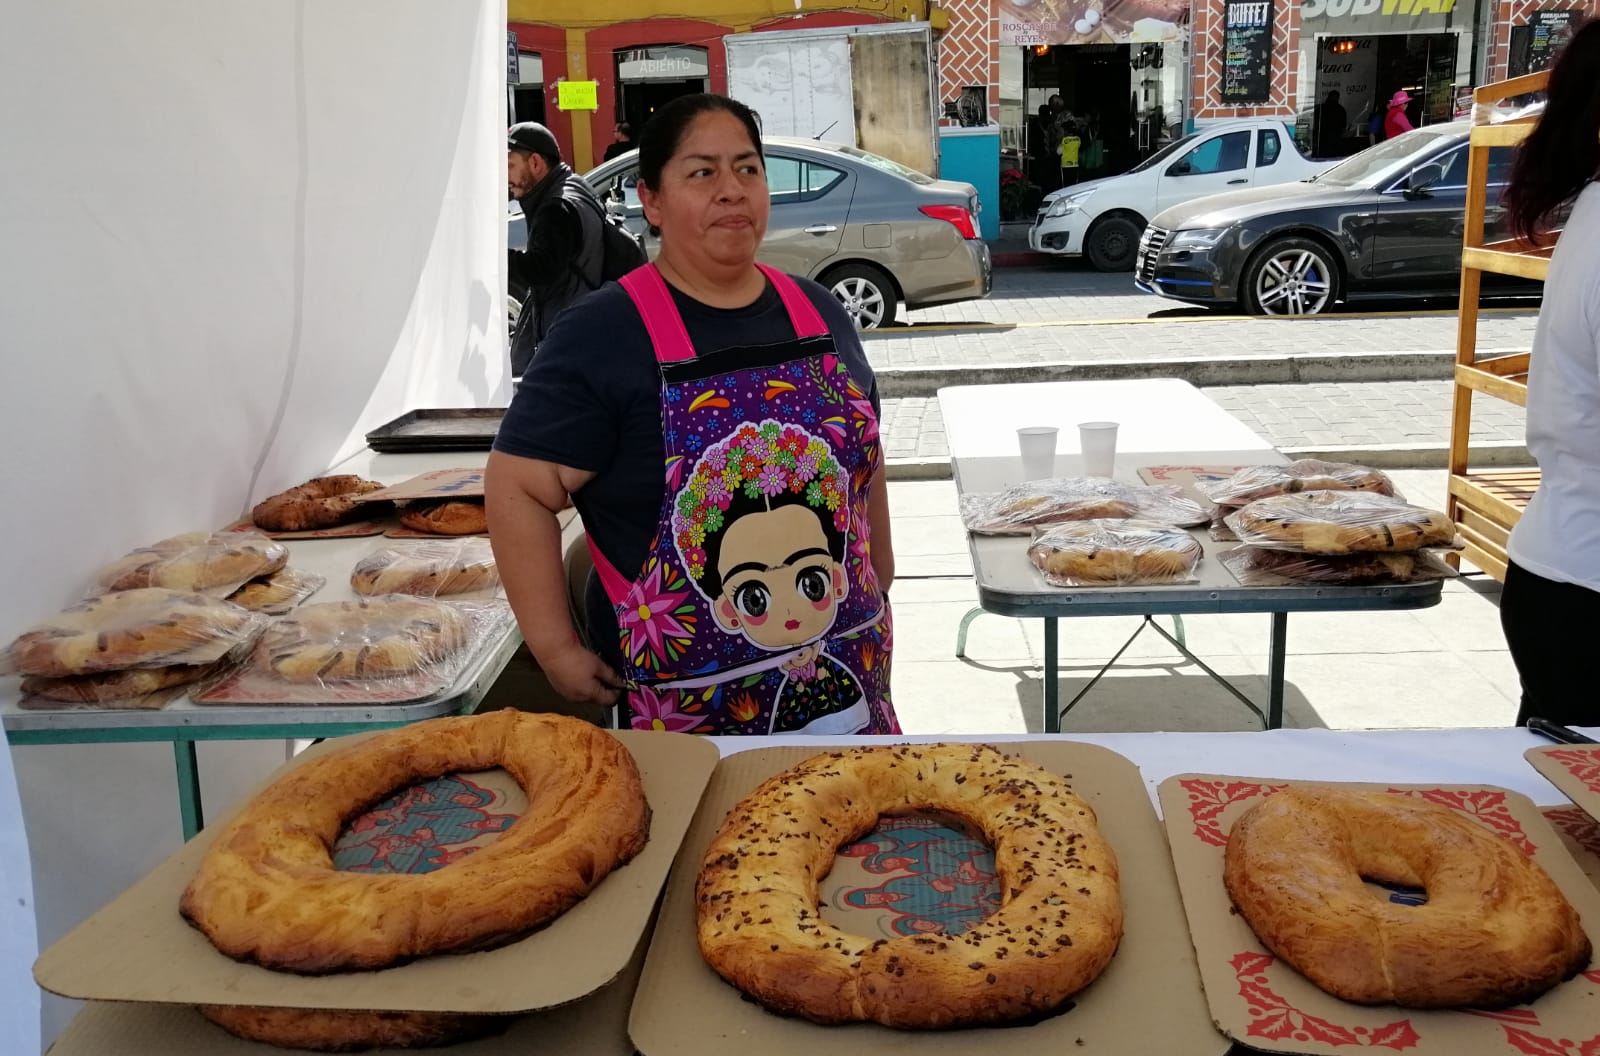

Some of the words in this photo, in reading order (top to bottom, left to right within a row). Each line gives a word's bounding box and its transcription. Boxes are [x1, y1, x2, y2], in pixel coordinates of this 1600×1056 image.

[1002, 23, 1041, 32] ROSCAS
[1014, 35, 1044, 43] REYES
[639, 56, 692, 74] ABIERTO
